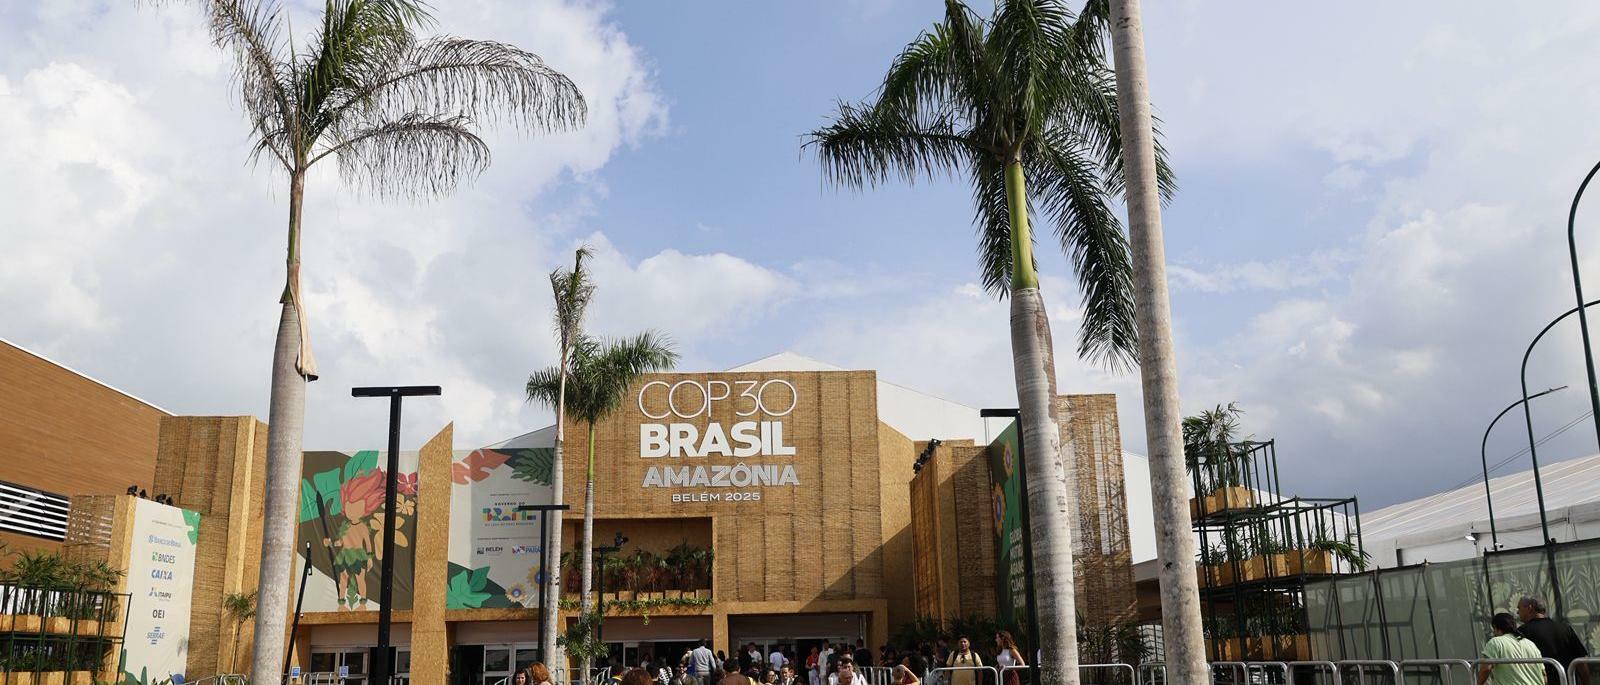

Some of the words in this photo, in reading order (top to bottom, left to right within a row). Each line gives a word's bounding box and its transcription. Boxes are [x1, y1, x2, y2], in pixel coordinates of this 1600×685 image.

[638, 379, 731, 419] COP
[735, 379, 797, 416] 30
[640, 421, 796, 458] BRASIL
[642, 462, 800, 488] AMAZÔNIA
[672, 491, 720, 502] BELÉM
[725, 492, 761, 501] 2025
[157, 553, 176, 564] BNDES
[151, 569, 173, 580] CAIXA
[152, 609, 165, 619] OEI
